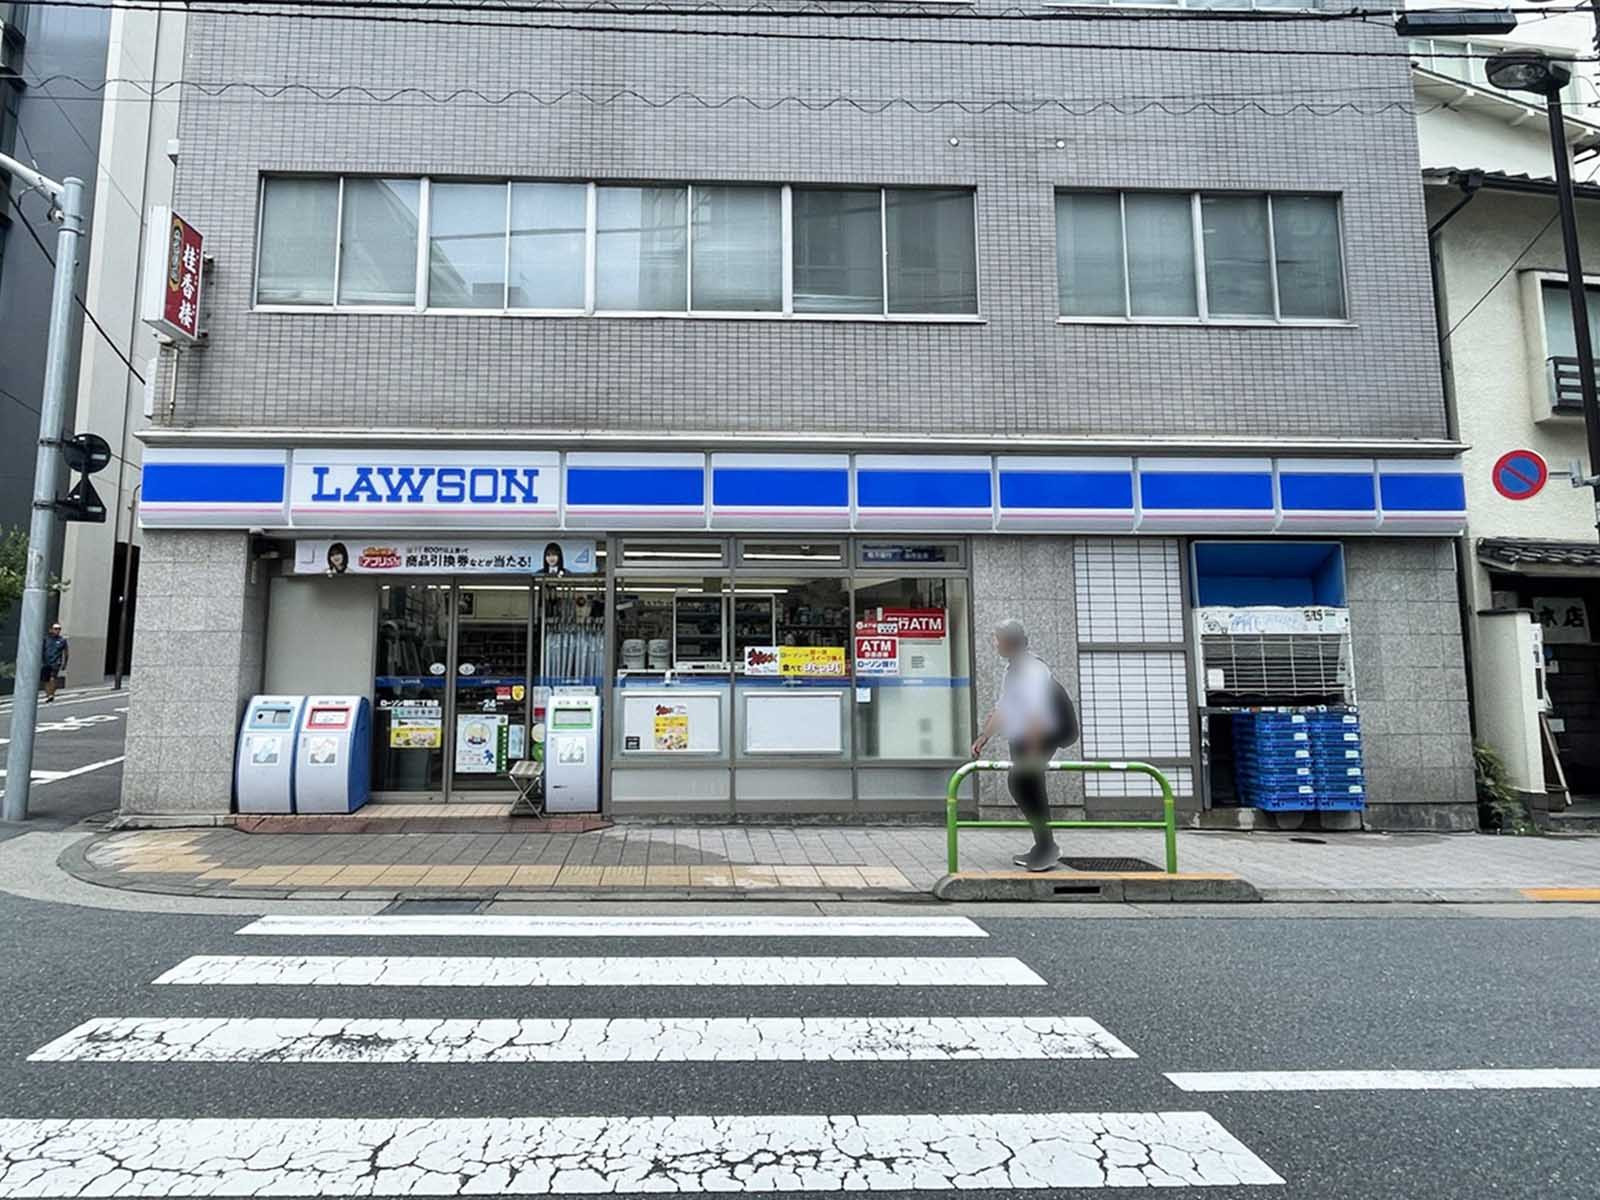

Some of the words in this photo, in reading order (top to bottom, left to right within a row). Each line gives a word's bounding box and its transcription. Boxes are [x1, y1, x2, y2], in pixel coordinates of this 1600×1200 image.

[312, 467, 539, 503] LAWSON
[886, 616, 942, 630] 行ATM
[861, 640, 891, 652] ATM
[857, 660, 896, 668] ローソン銀行
[482, 699, 497, 708] 24
